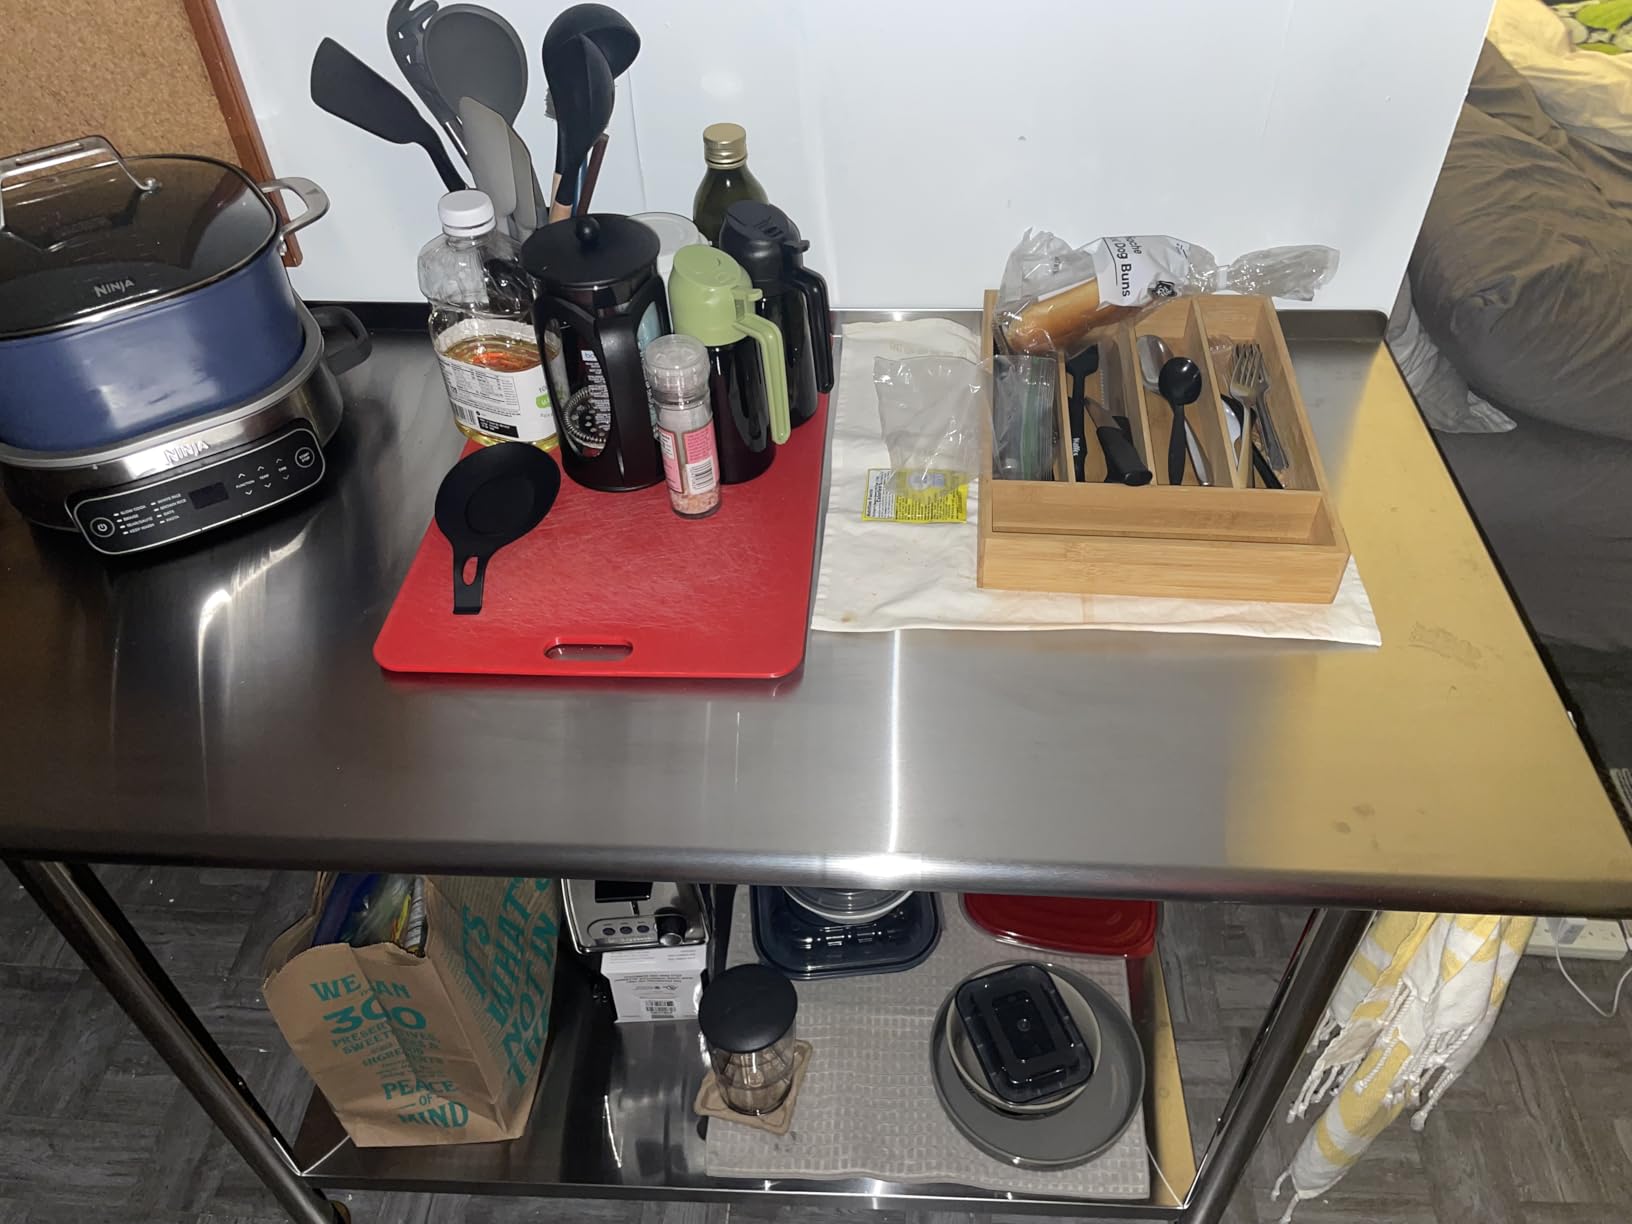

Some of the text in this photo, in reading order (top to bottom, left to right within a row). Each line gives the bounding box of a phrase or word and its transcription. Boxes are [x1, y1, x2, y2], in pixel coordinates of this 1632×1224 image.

[1114, 242, 1128, 260] Dog
[1121, 263, 1132, 297] Buns
[93, 279, 135, 298] NINJA
[163, 440, 210, 464] NINJA
[310, 973, 412, 1002] WE AN
[383, 1078, 457, 1101] PEACE
[418, 1094, 433, 1106] OF
[398, 1100, 469, 1129] MIND
